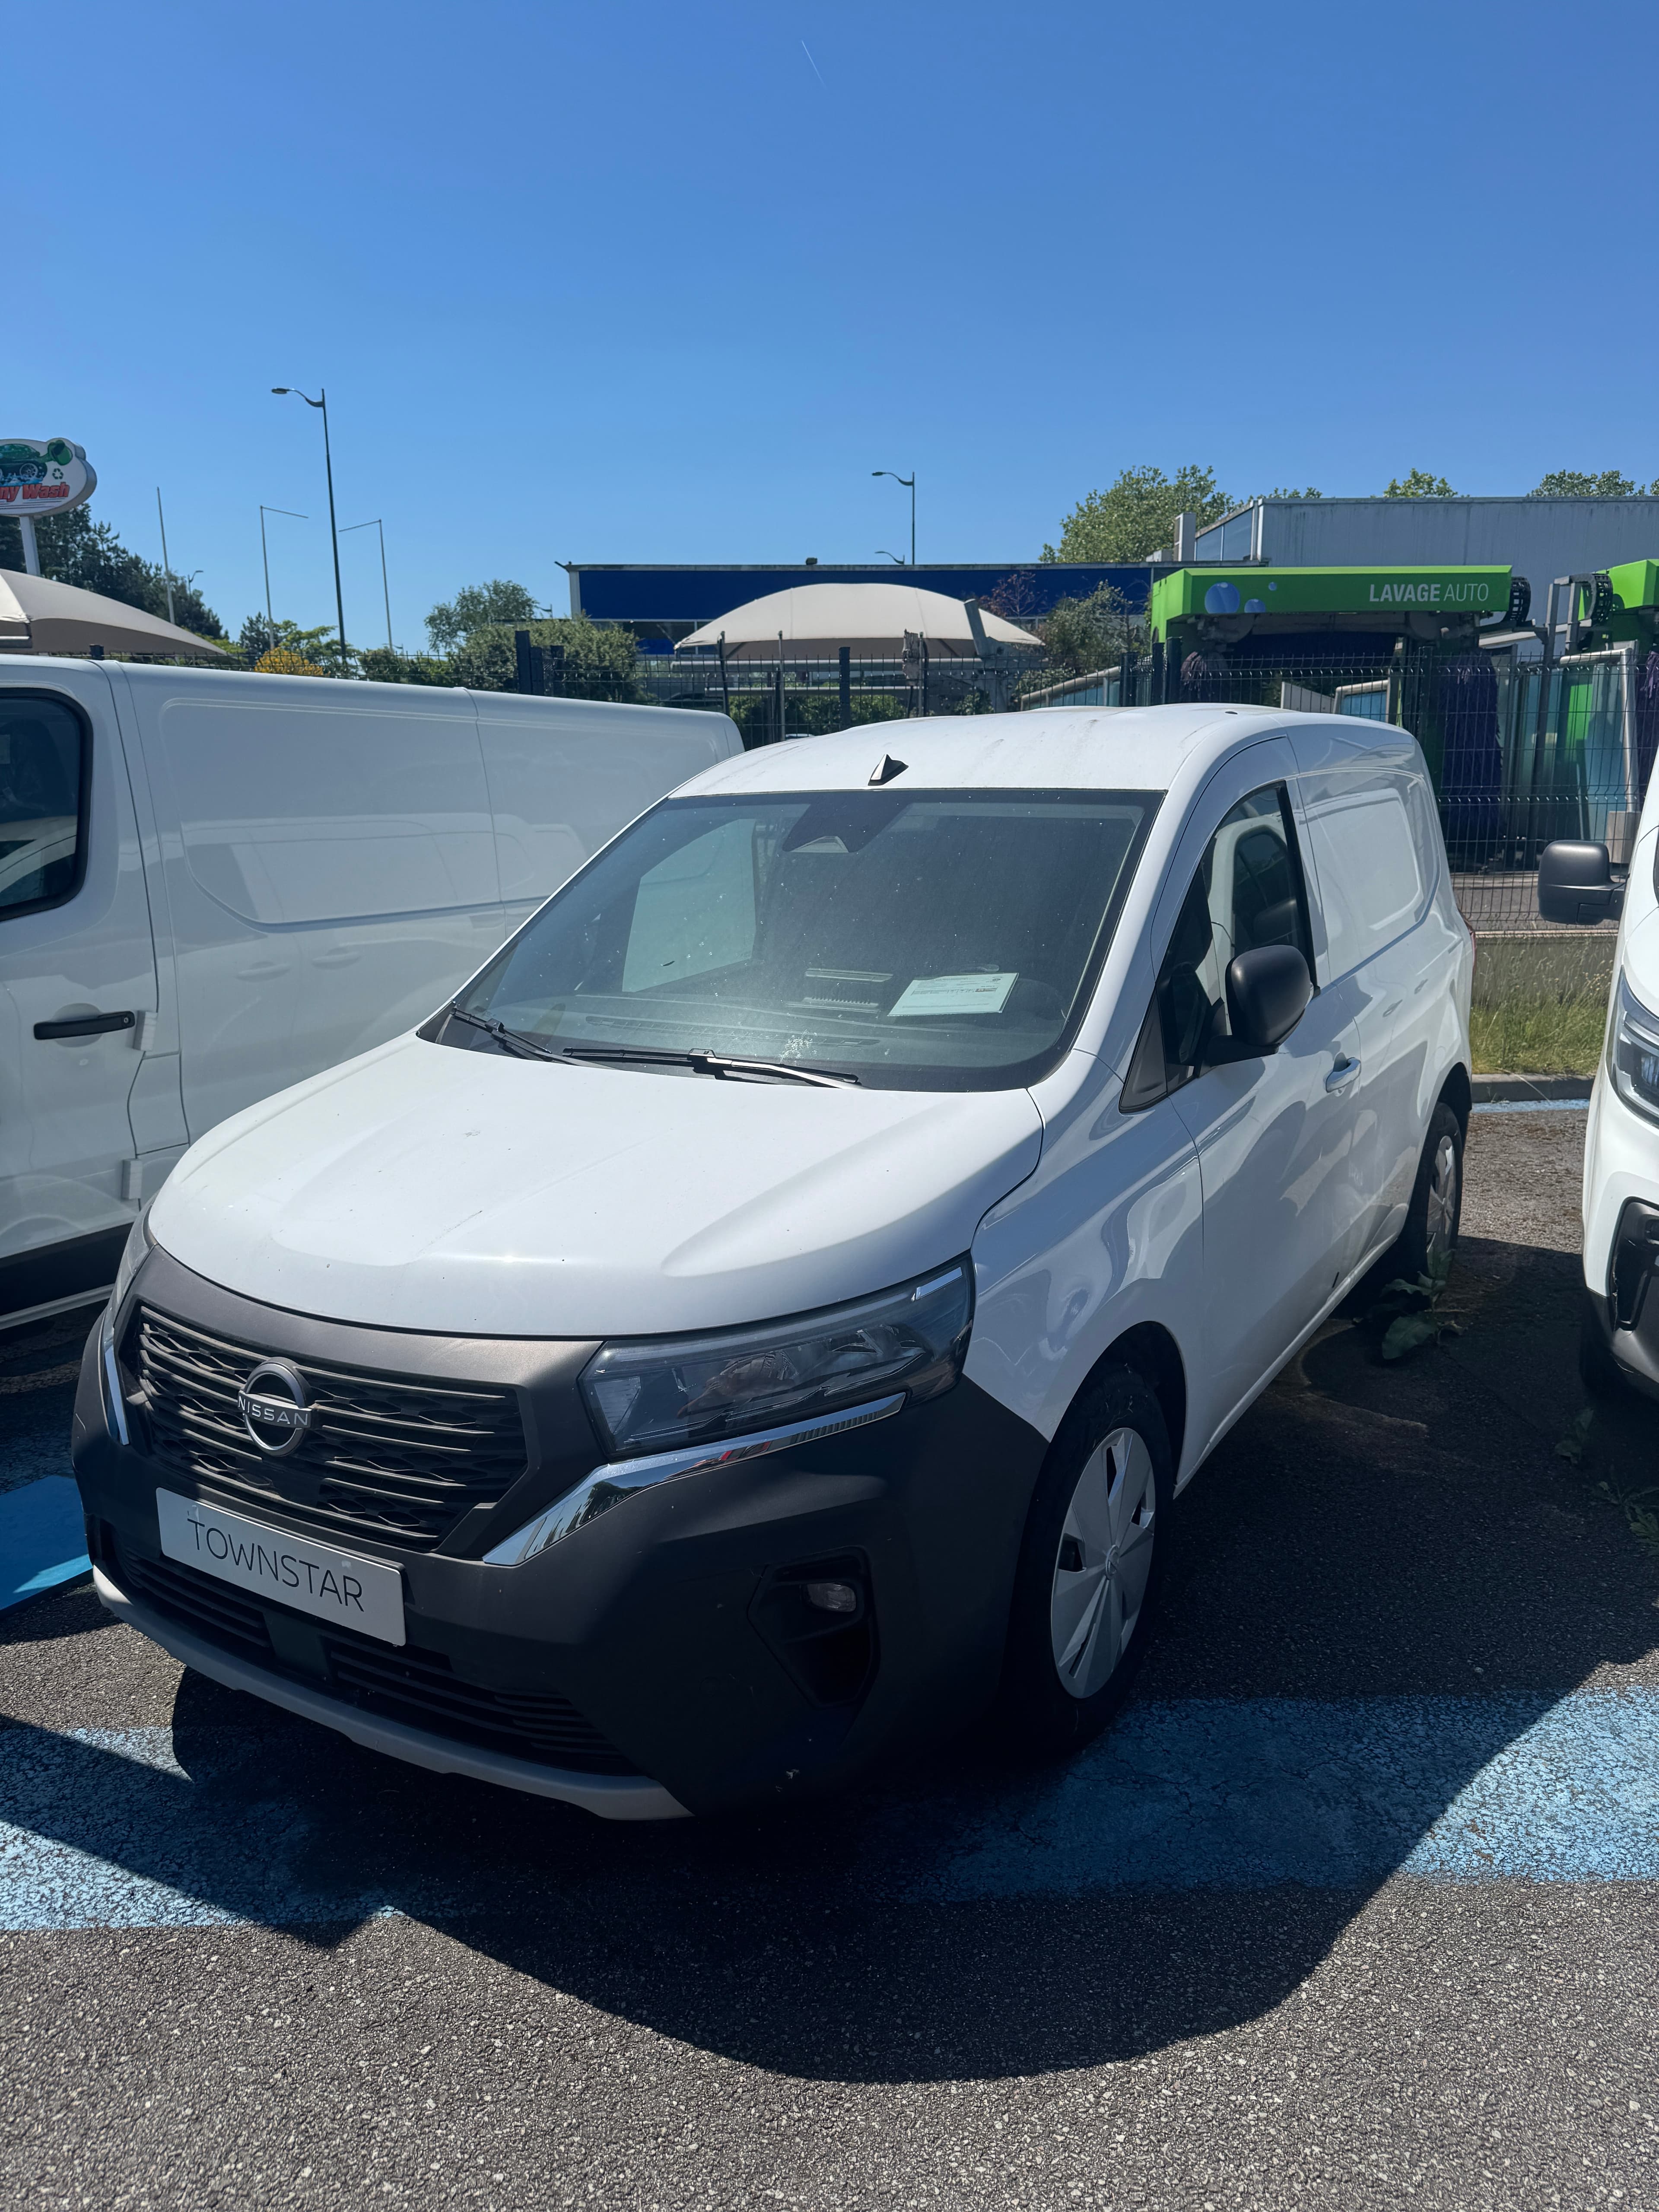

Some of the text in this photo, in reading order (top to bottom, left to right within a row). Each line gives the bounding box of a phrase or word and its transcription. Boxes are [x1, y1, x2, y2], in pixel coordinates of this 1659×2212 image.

[22, 482, 70, 499] Wash
[1369, 583, 1489, 602] LAVAGE AUTO
[238, 1396, 308, 1426] NISSAN
[187, 1518, 364, 1612] TOWNSTAR
